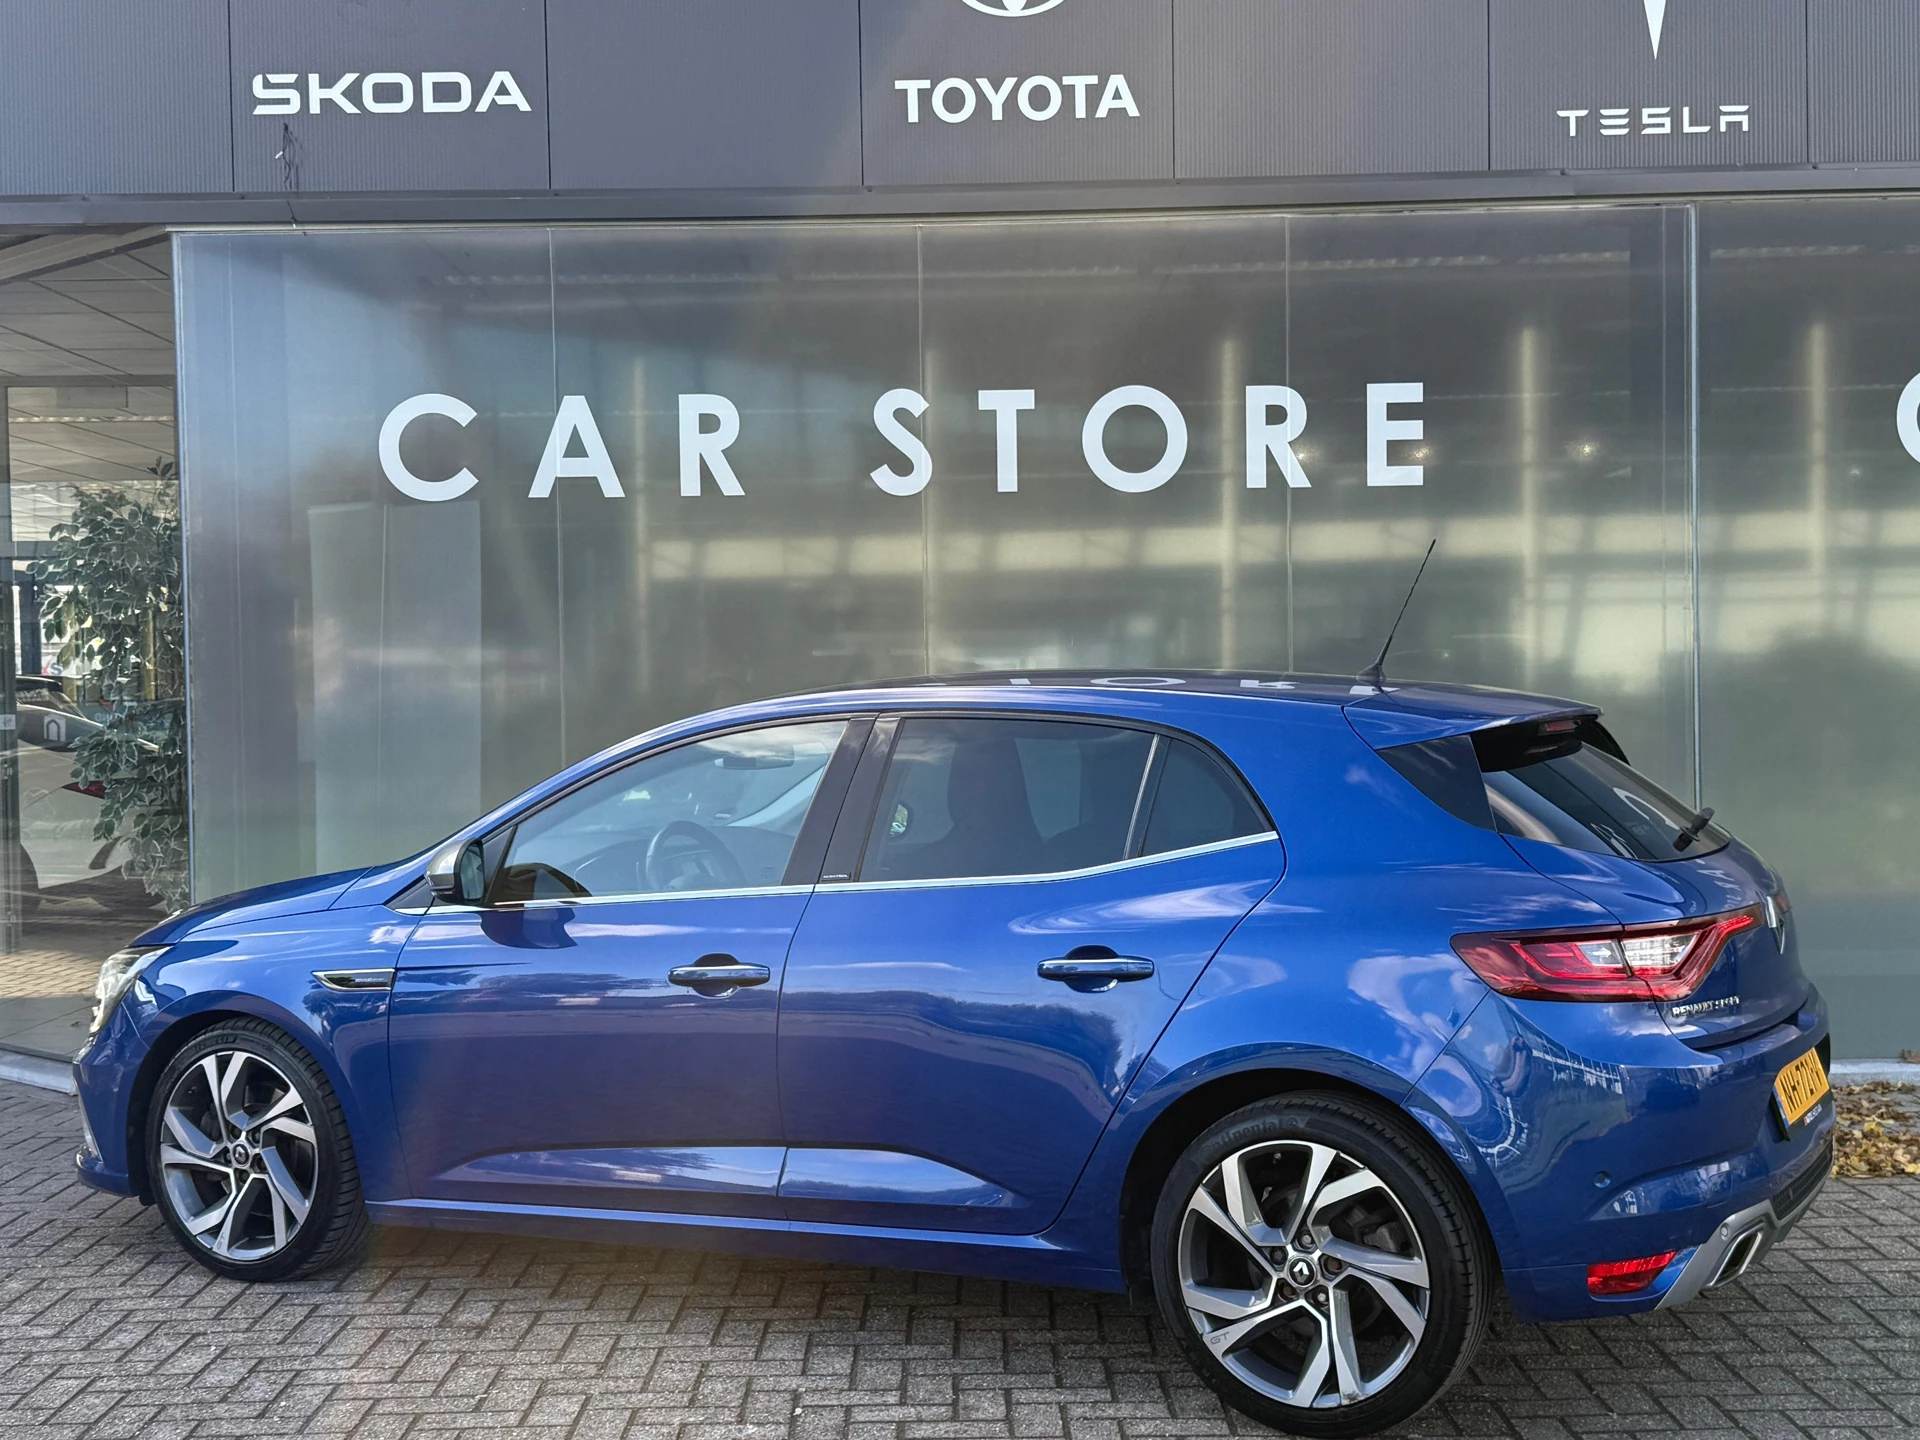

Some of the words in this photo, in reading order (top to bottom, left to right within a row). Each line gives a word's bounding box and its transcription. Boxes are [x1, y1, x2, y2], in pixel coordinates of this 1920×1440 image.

[894, 73, 1141, 124] TOYOTA
[1556, 104, 1750, 137] TESLA
[378, 393, 746, 503] CAR
[869, 382, 1426, 496] STORE
[1210, 1331, 1230, 1345] GT
